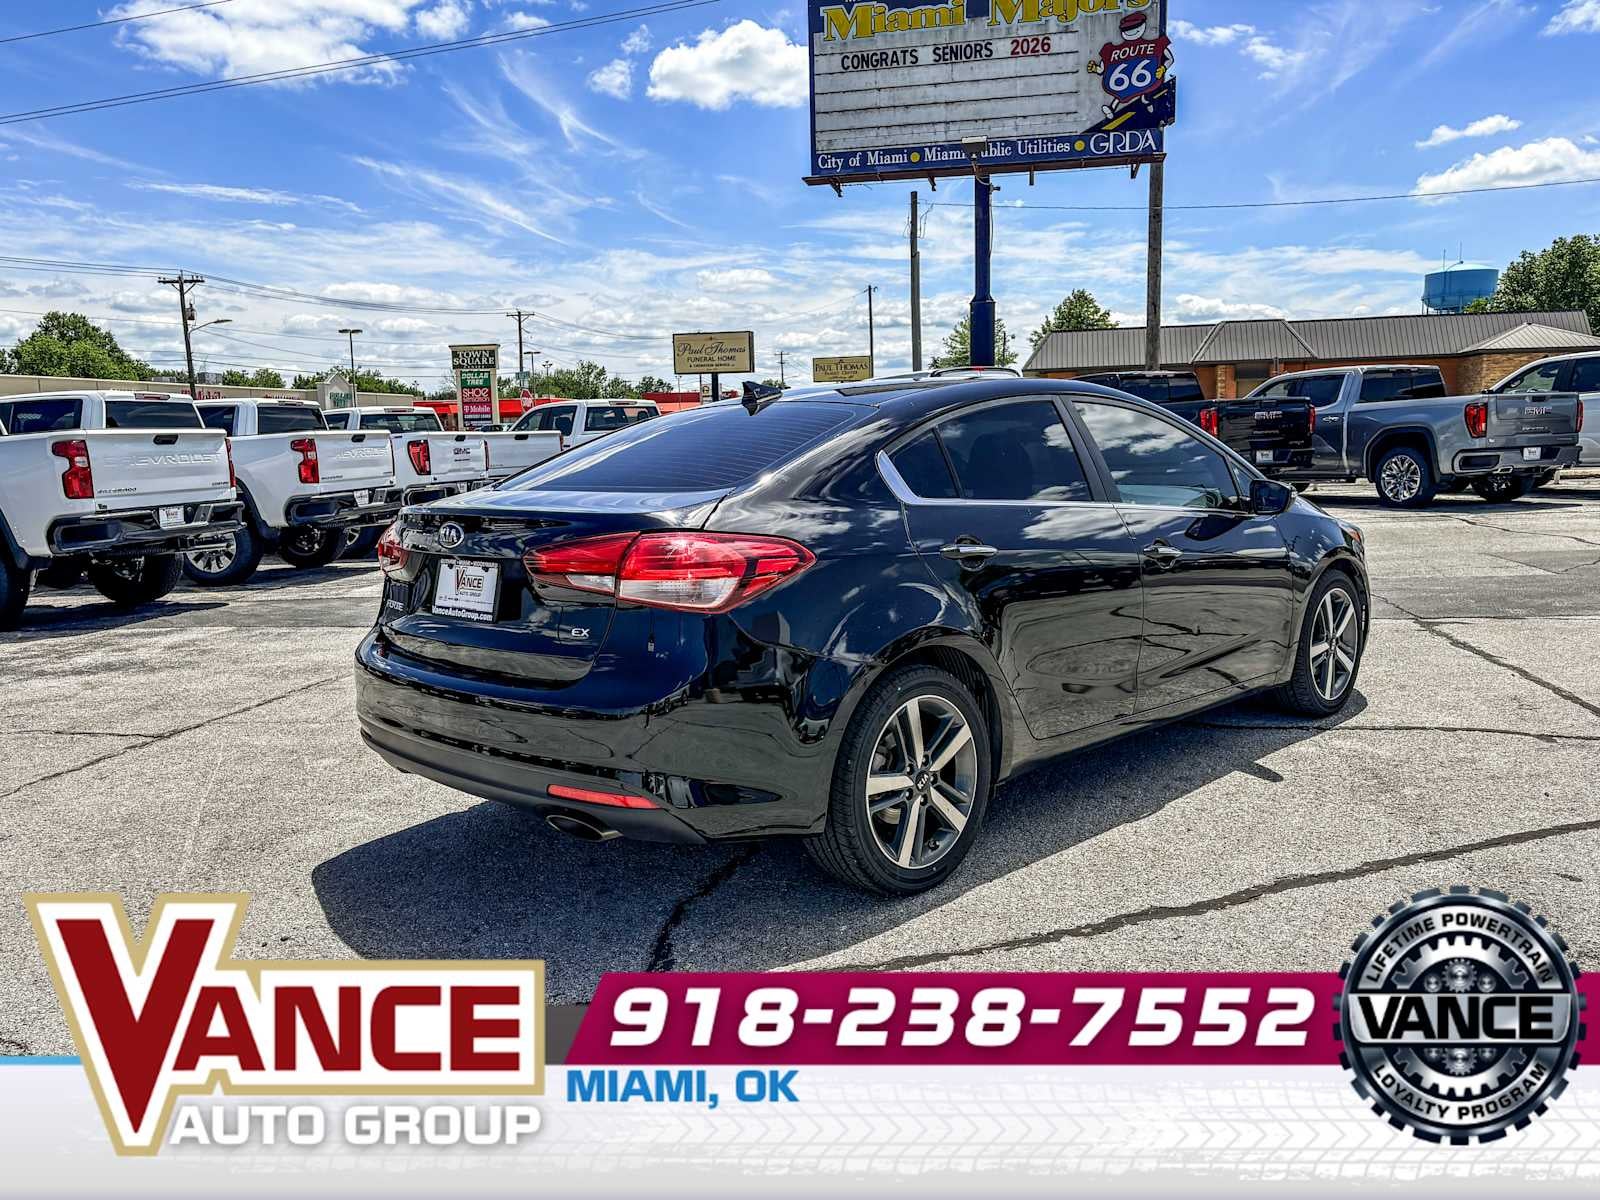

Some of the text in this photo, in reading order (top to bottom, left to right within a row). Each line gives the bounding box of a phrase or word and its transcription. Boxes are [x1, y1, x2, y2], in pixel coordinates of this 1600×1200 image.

[822, 0, 967, 41] Miami
[841, 37, 1051, 71] CONGRATS SENIORS 2026
[1110, 43, 1156, 62] ROUTE
[1109, 59, 1152, 92] 66
[818, 129, 1157, 172] City of Miami Miami ublic Utilities GRDA
[677, 341, 746, 356] Paul Thomas
[453, 358, 495, 366] SQUARE
[815, 362, 868, 371] PAUL THOMAS
[440, 526, 458, 543] KIA
[456, 567, 483, 593] VANCE
[432, 605, 493, 621] VanceAutoGroup.com
[571, 627, 590, 638] EX
